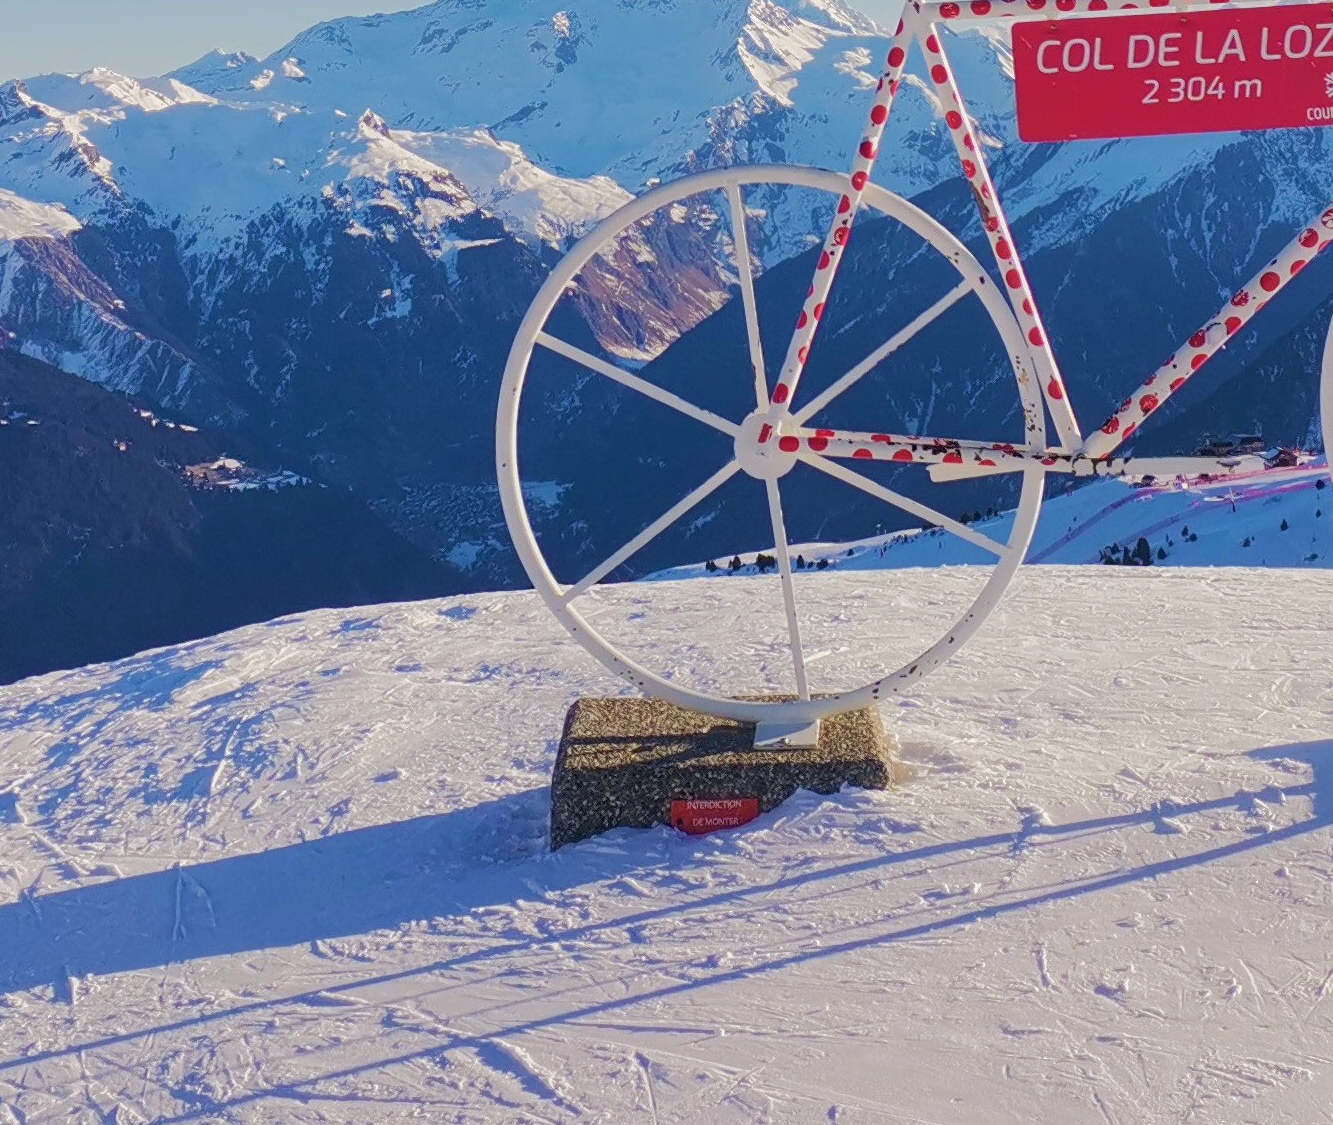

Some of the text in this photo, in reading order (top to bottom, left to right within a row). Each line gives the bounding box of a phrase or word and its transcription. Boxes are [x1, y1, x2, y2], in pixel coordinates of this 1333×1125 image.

[1036, 37, 1114, 75] COL
[1127, 32, 1182, 70] DE
[1195, 28, 1246, 66] LA
[1141, 76, 1262, 105] 2 304 m
[686, 799, 742, 810] INTERDICTION
[692, 817, 739, 827] DE MONTER
